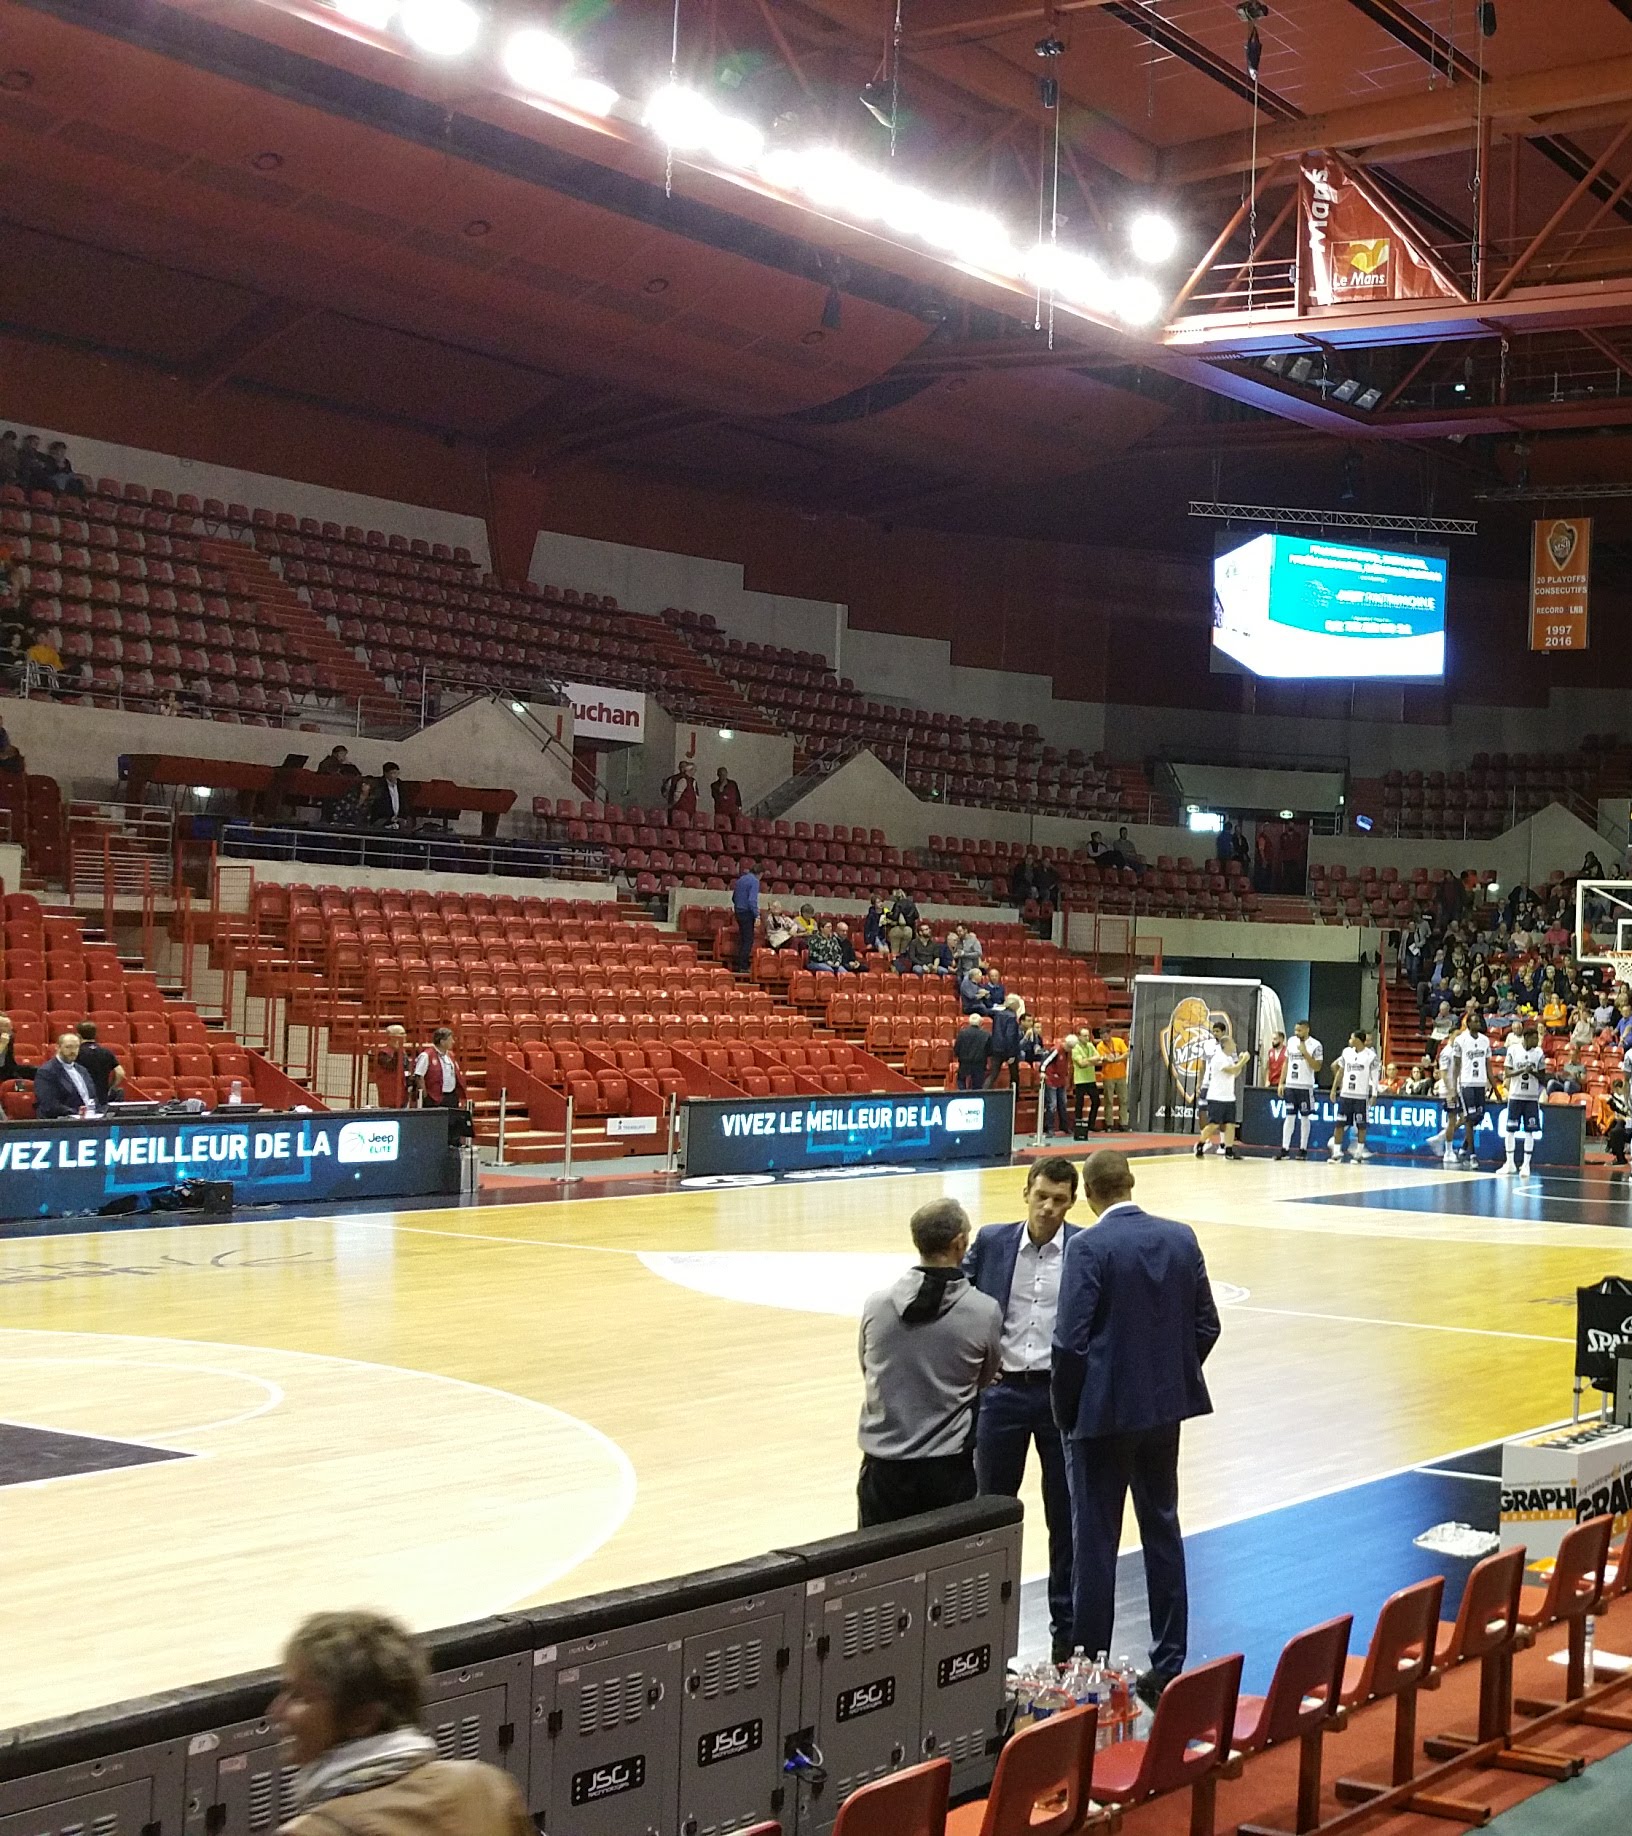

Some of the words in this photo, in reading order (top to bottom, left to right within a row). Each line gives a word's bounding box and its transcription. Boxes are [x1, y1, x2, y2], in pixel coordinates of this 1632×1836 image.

[1350, 271, 1385, 286] Mans
[1547, 575, 1586, 584] PLAYOFFS
[1535, 586, 1587, 596] CONSECUTIFS
[1546, 625, 1572, 635] 1997
[1545, 637, 1572, 646] 2016
[572, 702, 640, 727] uchan
[686, 732, 696, 758] J
[722, 1113, 776, 1136] VIVEZ
[780, 1111, 802, 1133] LE
[806, 1107, 893, 1132] MEILLEUR
[896, 1106, 919, 1128] DE
[920, 1106, 942, 1126] LA
[368, 1133, 394, 1143] Jeep
[59, 1139, 98, 1167] LE
[104, 1133, 247, 1166] MEILLEUR
[254, 1132, 290, 1159] DE
[297, 1131, 331, 1157] LA
[1500, 1487, 1577, 1513] GRAPHI
